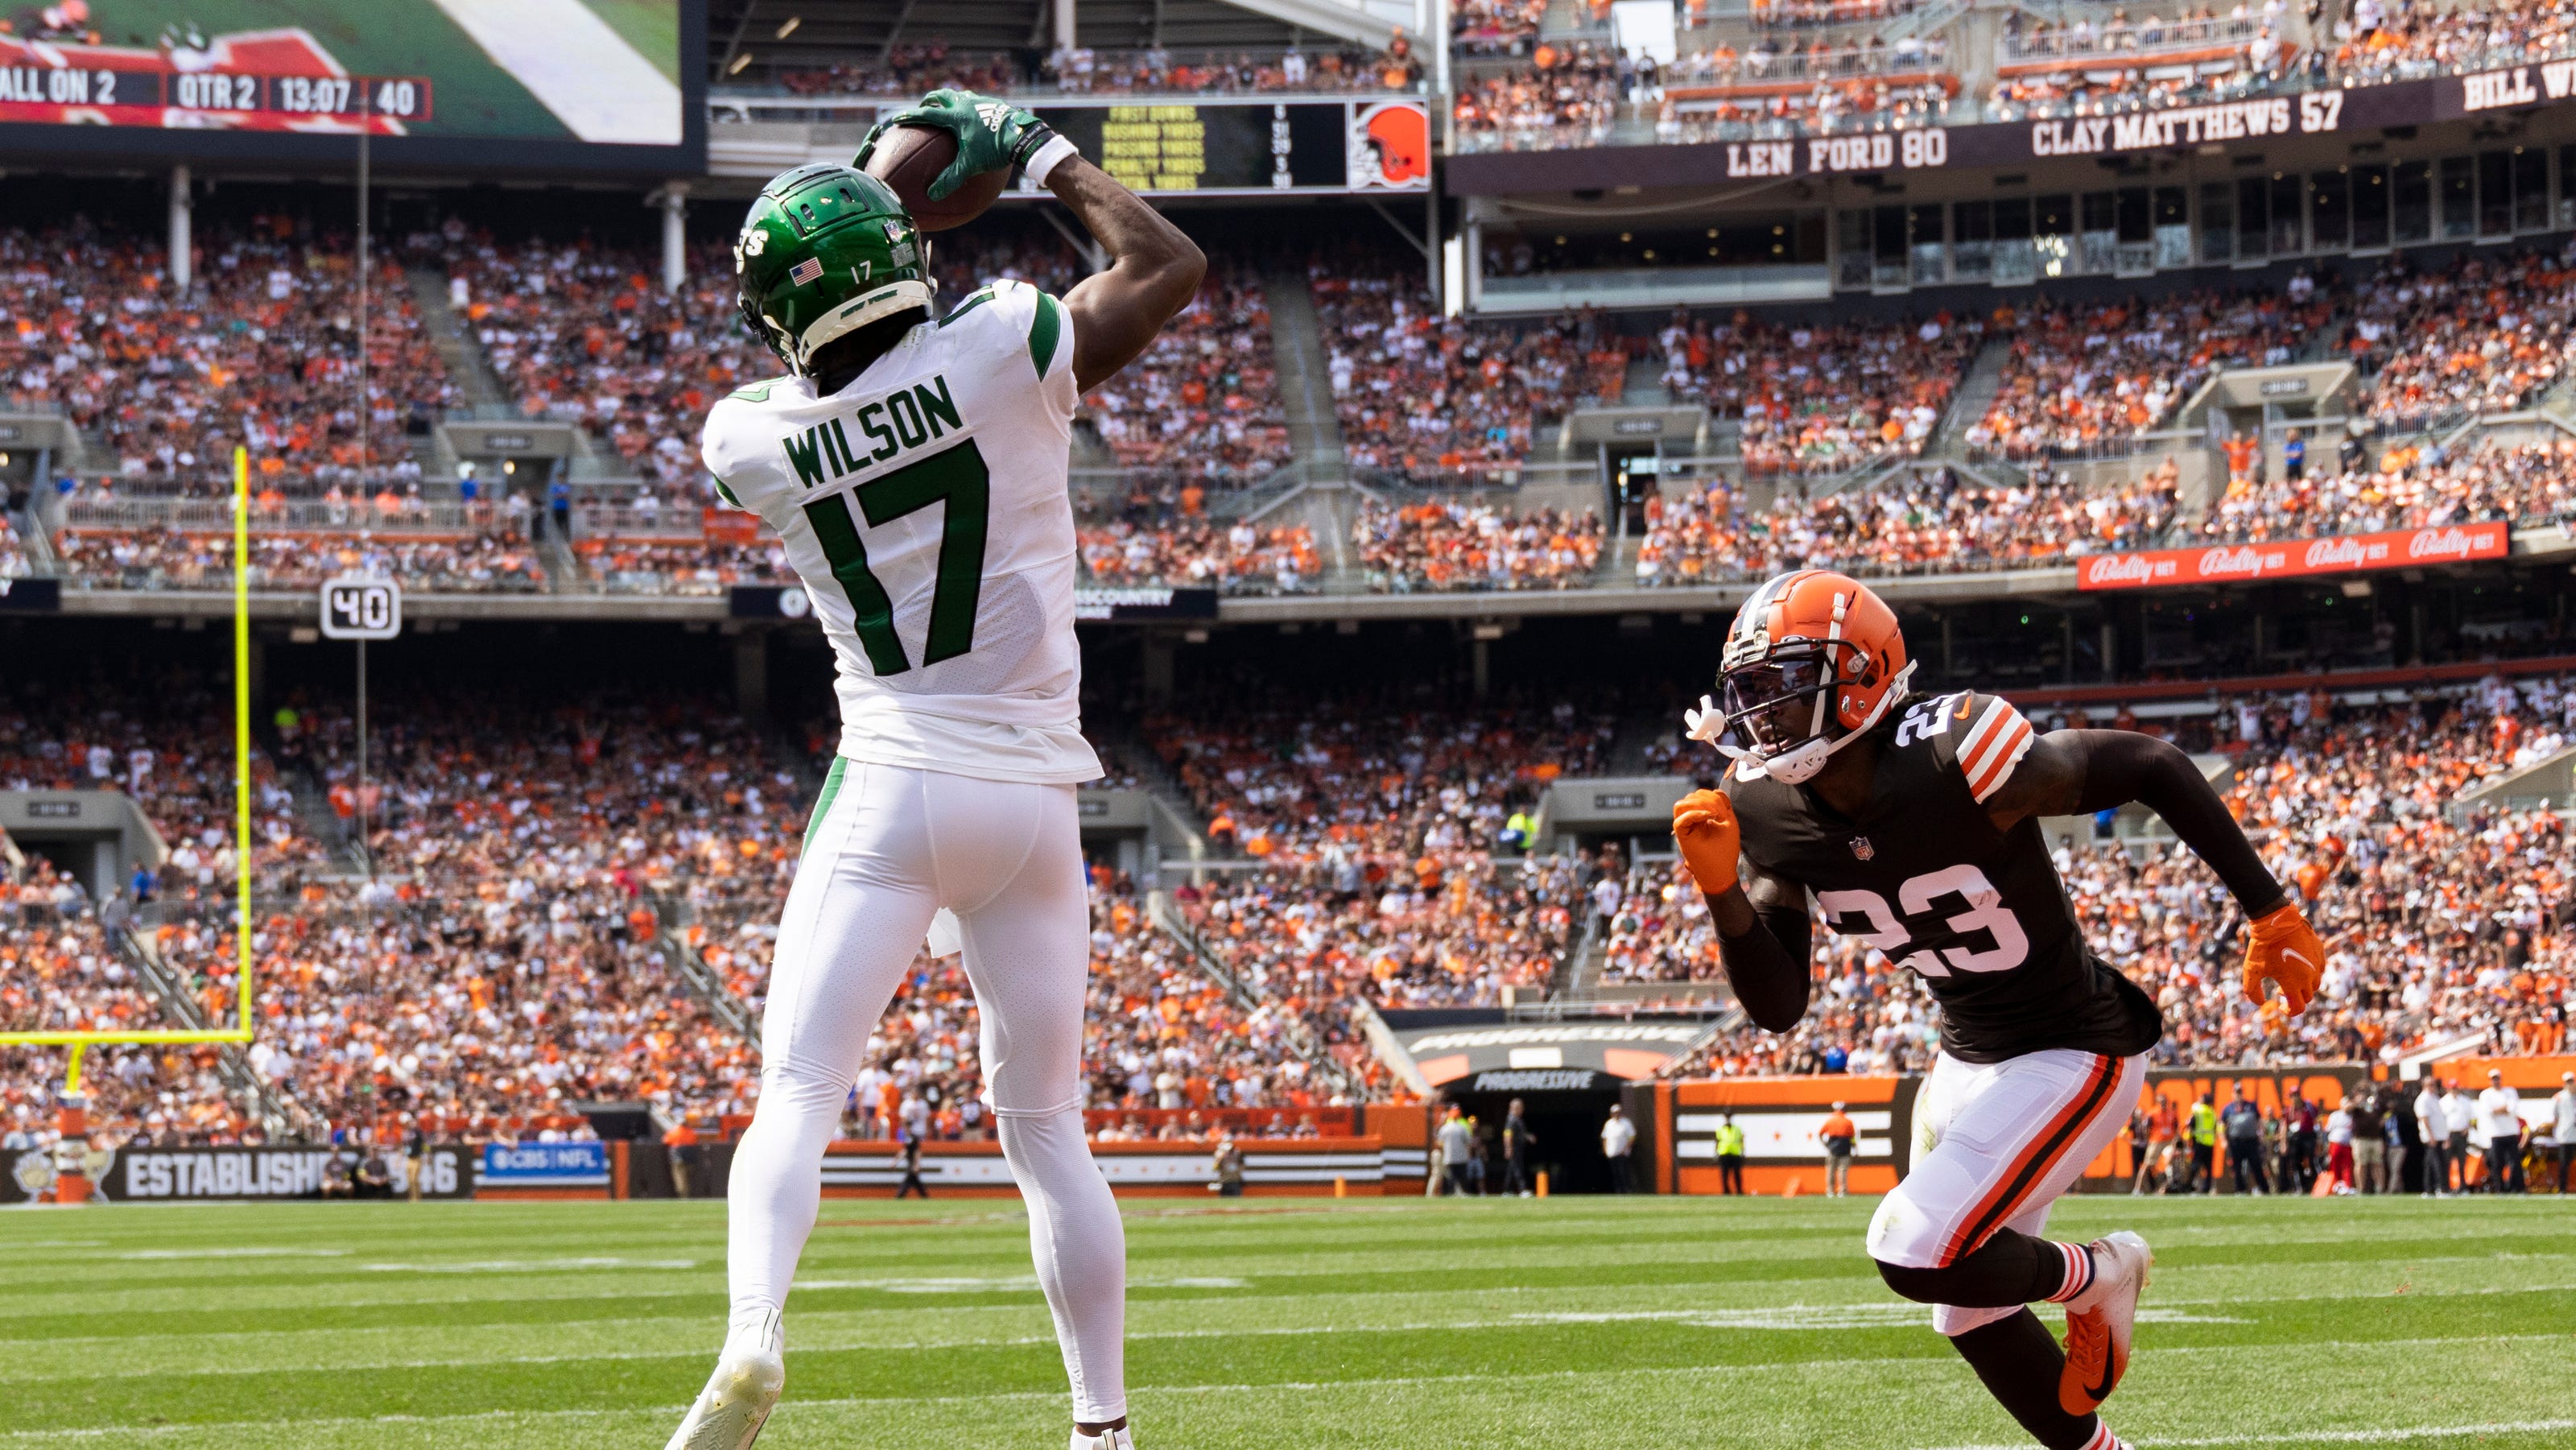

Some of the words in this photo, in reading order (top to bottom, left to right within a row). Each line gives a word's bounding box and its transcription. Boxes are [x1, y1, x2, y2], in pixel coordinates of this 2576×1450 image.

[48, 68, 89, 104] ON
[95, 69, 116, 105] 2
[178, 73, 232, 109] QTR
[236, 74, 256, 109] 2
[281, 76, 351, 113] 13:07
[376, 80, 415, 116] 40
[2463, 67, 2537, 111] BILL
[2033, 118, 2110, 156] CLAY
[2112, 98, 2291, 151] MATTHEWS
[2300, 90, 2344, 132] 57
[1727, 141, 1794, 177] LEN
[1808, 134, 1893, 173] FORD
[1901, 127, 1947, 168] 80
[850, 259, 871, 284] 17
[840, 300, 866, 320] NEW
[867, 288, 899, 306] YORK
[782, 374, 964, 490] WILSON
[802, 436, 990, 677] 17
[2198, 546, 2264, 577] Bally
[2305, 538, 2368, 568] Bally
[2409, 528, 2472, 559] Bally
[2088, 553, 2155, 585] Bally
[332, 589, 390, 629] 40
[1817, 863, 2029, 977] 23
[1409, 1025, 1702, 1054] PROGRESSIVE
[1473, 1069, 1598, 1091] PROGRESSIVE
